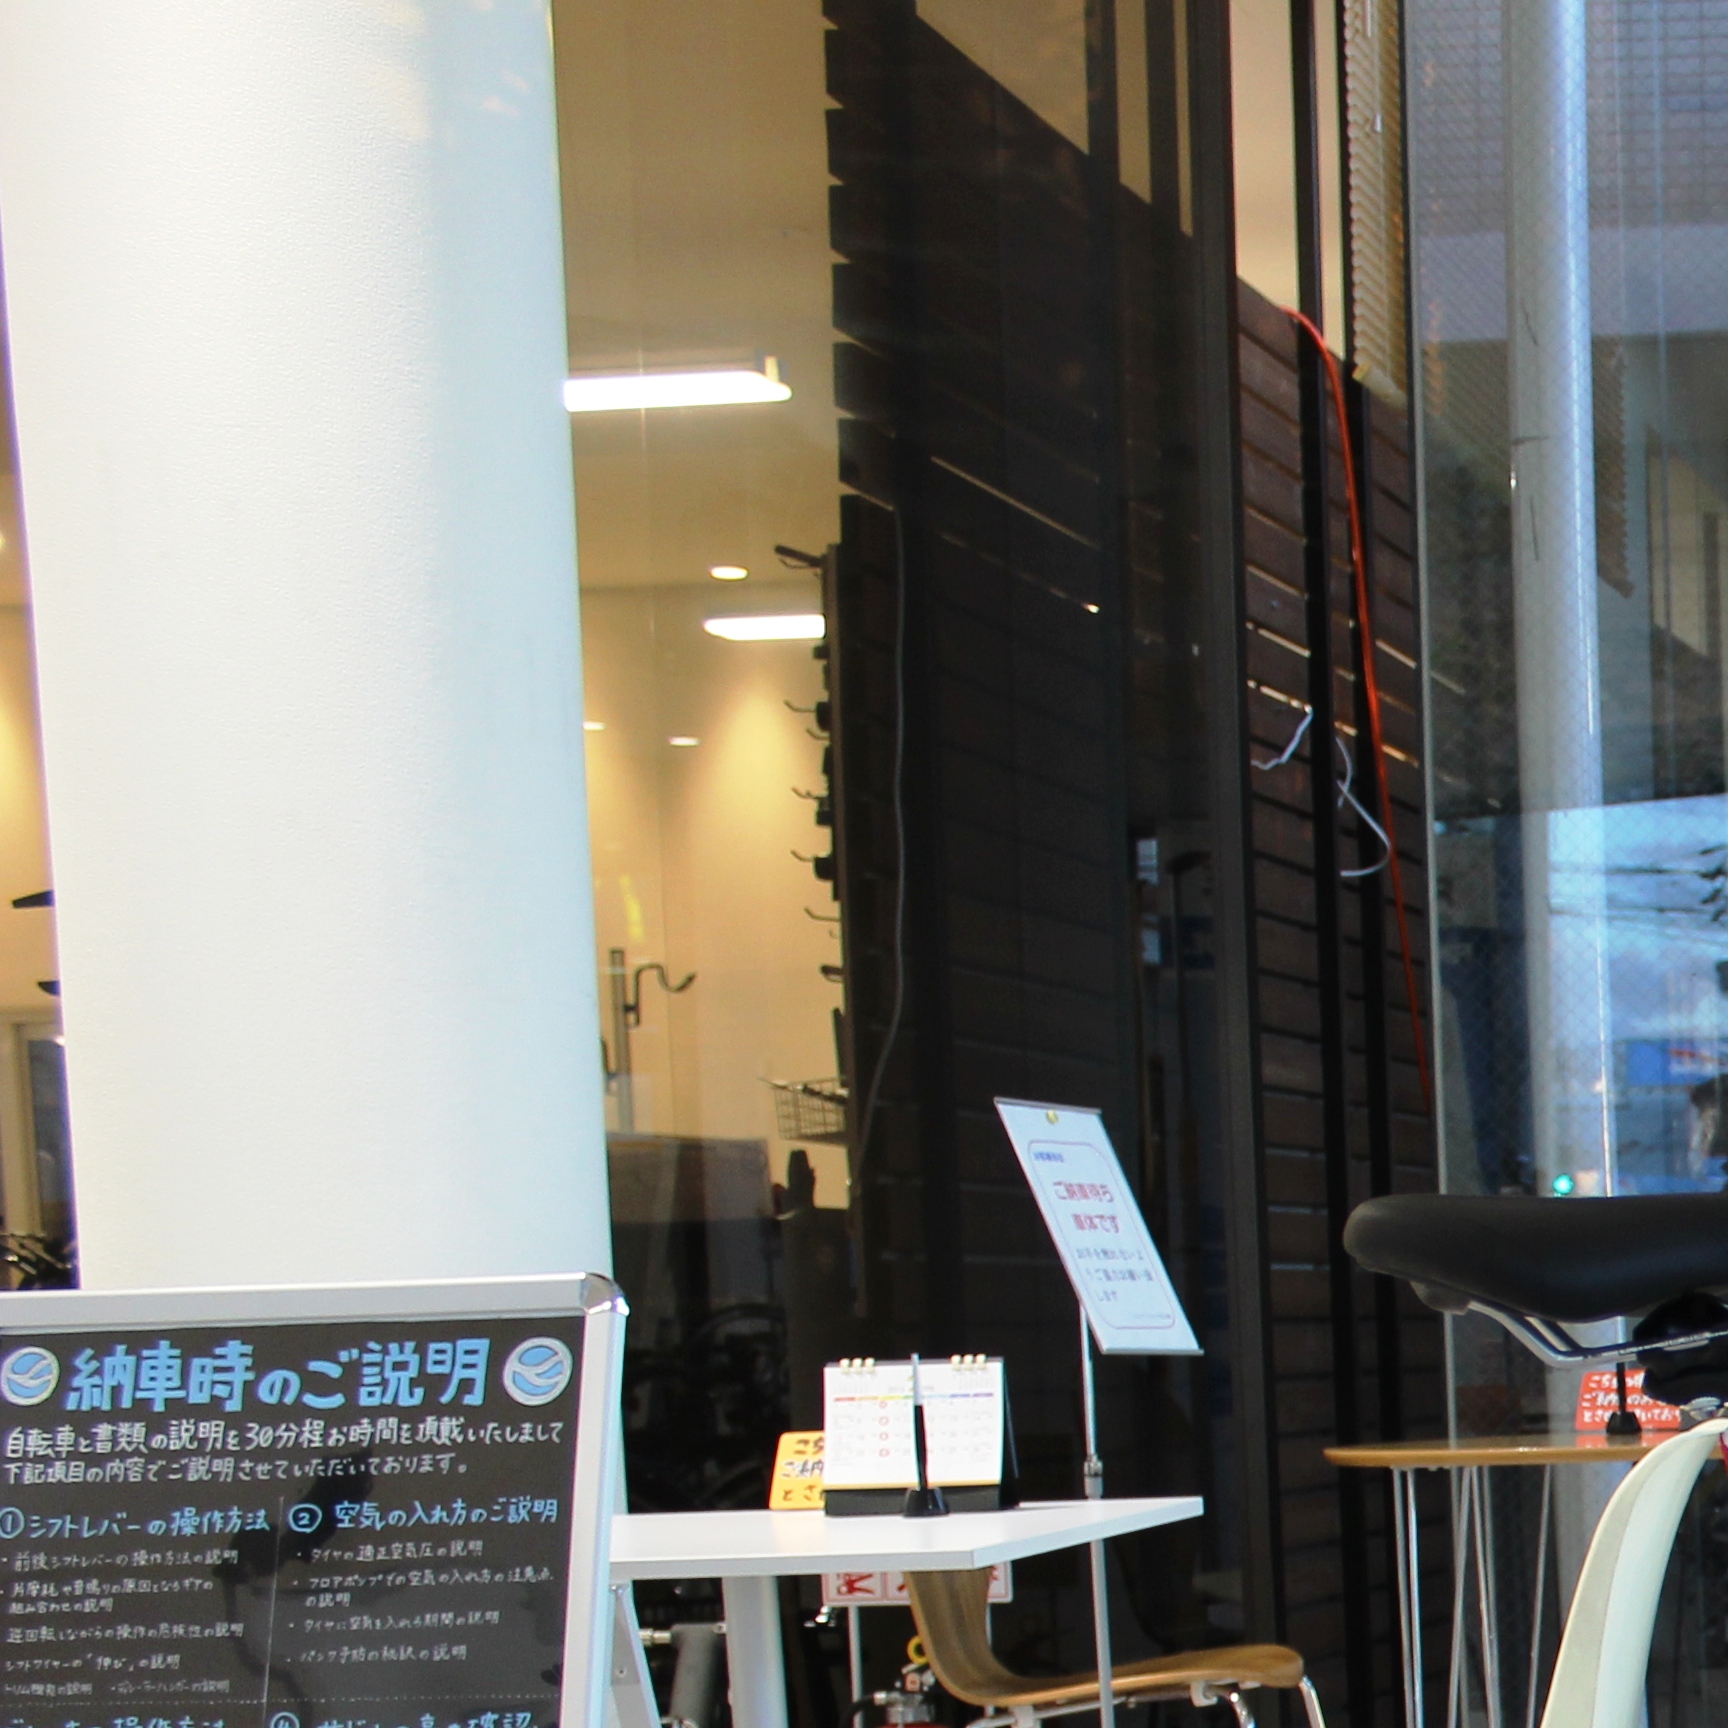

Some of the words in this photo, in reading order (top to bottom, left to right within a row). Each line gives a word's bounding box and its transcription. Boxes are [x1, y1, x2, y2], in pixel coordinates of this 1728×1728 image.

[66, 1337, 490, 1413] 納車時のご説明
[30, 1505, 271, 1539] シフトレバーの操作方法
[335, 1495, 559, 1530] 空気の入れ方のご説明
